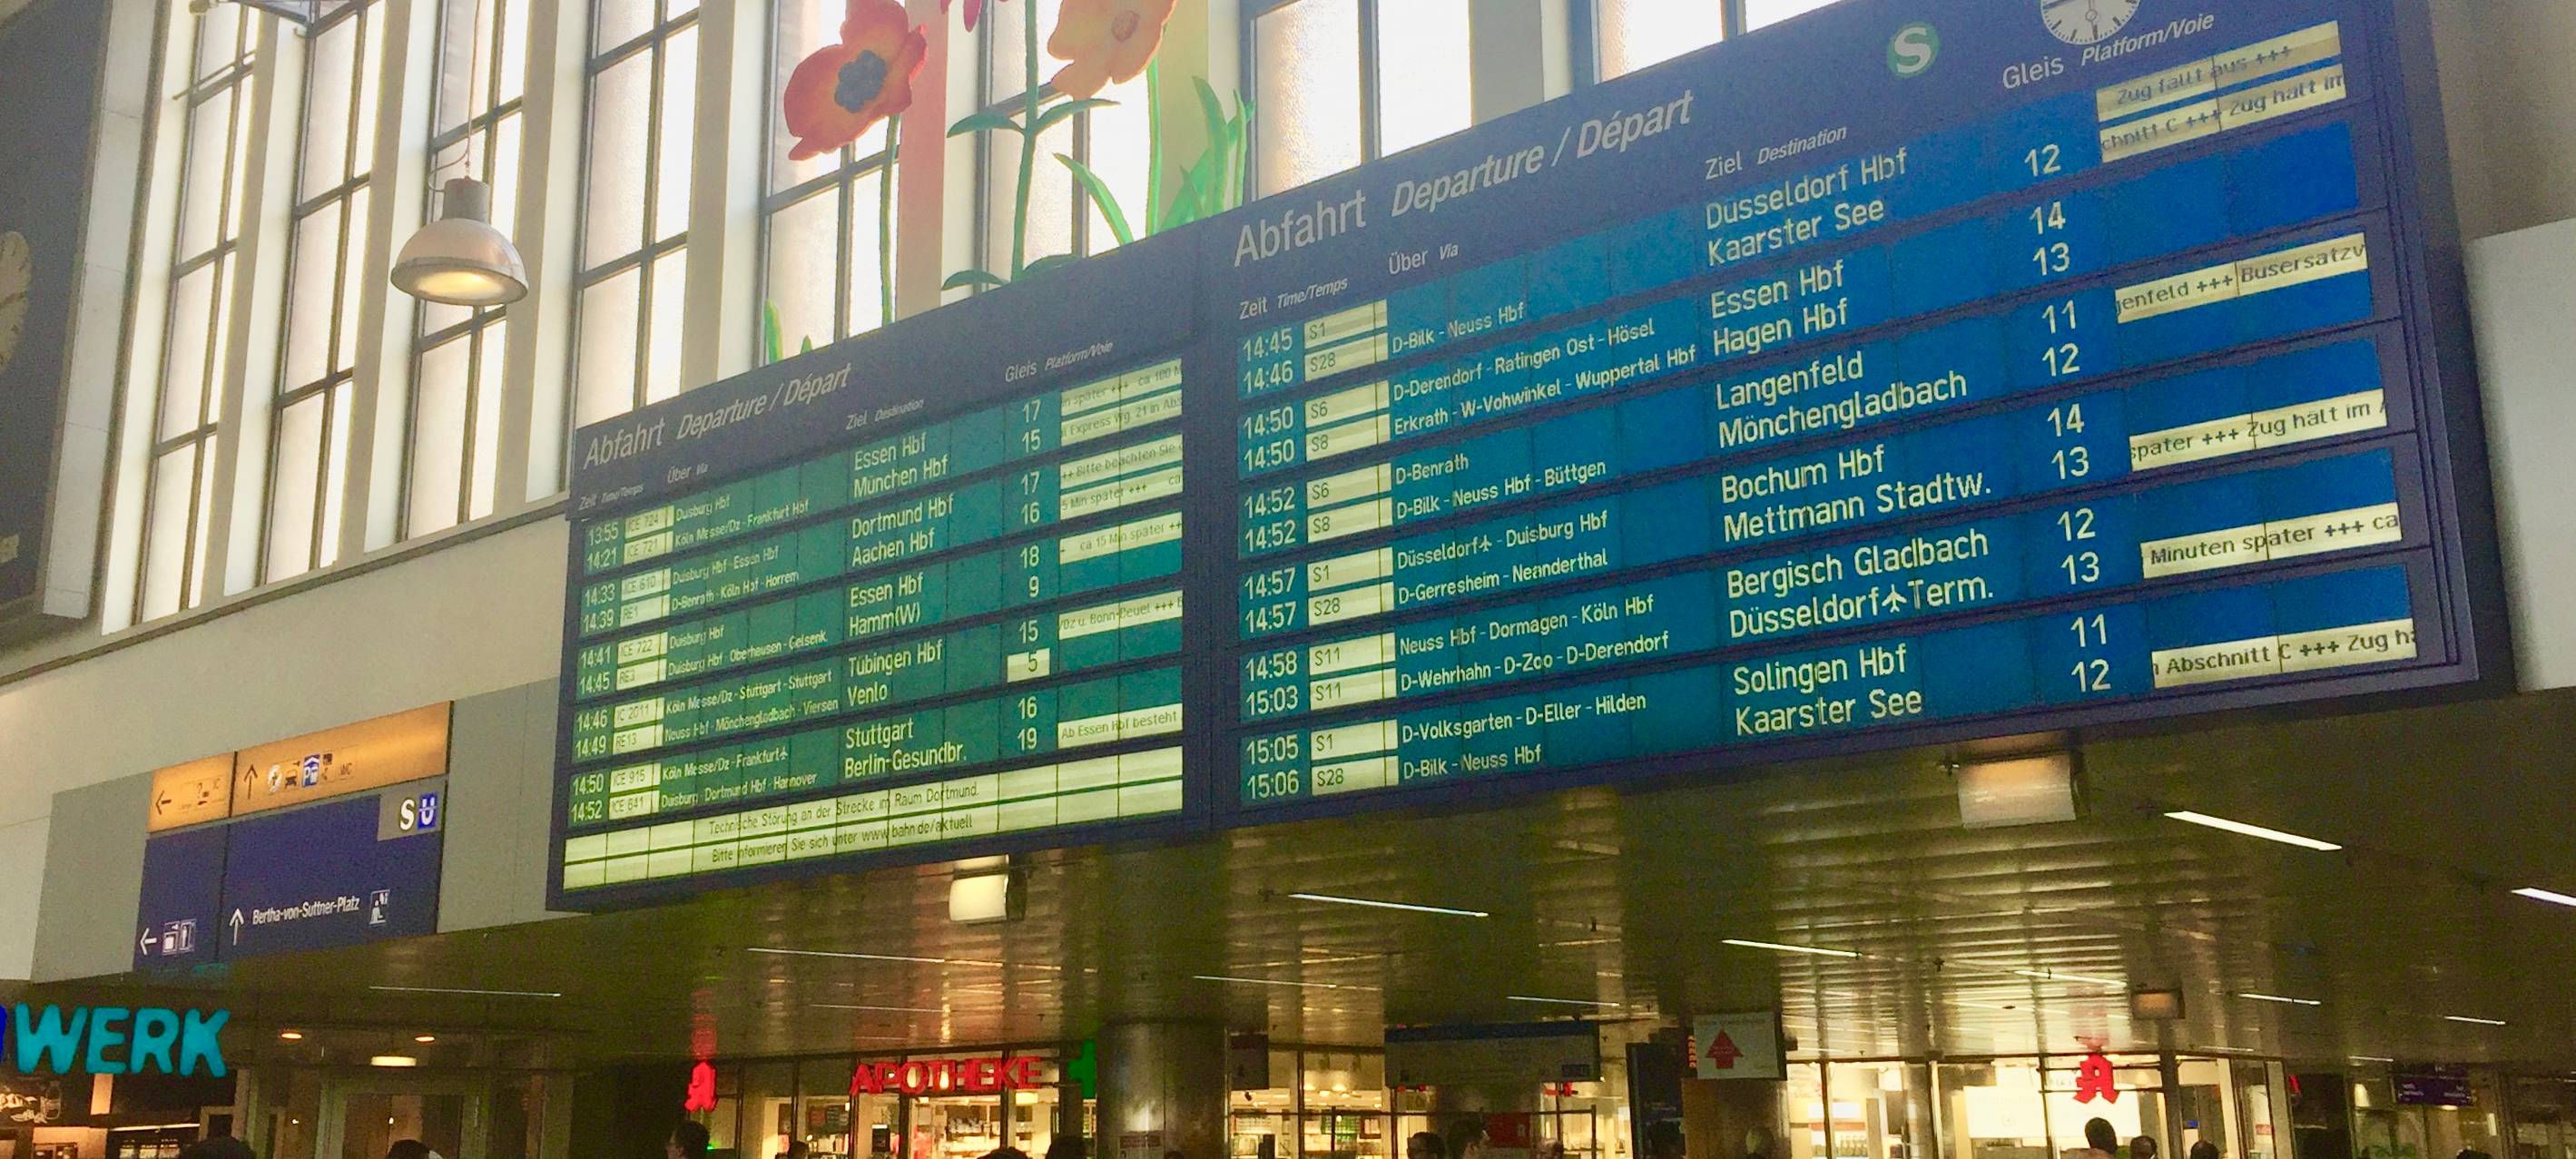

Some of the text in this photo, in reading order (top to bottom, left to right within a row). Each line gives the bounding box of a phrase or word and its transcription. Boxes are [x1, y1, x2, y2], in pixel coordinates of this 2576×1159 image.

[1892, 26, 1934, 74] S
[2002, 11, 2216, 90] Gleis Platform/Voie
[2118, 83, 2151, 106] Zug
[1705, 125, 1847, 181] Ziel Destination
[1861, 148, 1907, 185] Hbf
[2024, 143, 2061, 177] 12
[1234, 89, 1695, 268] Abfahrt Departure Départ
[1708, 197, 1885, 266] Kaarster See
[2030, 201, 2066, 235] 14
[1390, 242, 1460, 275] Über Via
[2032, 241, 2070, 276] 13
[1240, 277, 1348, 320] Zeit Time/Temps
[1711, 260, 1844, 319] Essen Hbf
[1310, 322, 1327, 340] S1
[1392, 302, 1525, 356] D-Bilk Neuss Hbf
[1713, 298, 1848, 356] Hagen Hbf
[2042, 300, 2076, 334] 11
[1005, 340, 1114, 382] Gleis Platform/Voie
[1242, 327, 1294, 363] 14:45
[1393, 319, 1656, 403] D-Derendorf Ratingen Ost Hösel
[2042, 341, 2079, 377] 12
[1242, 360, 1294, 395] 14:46
[1310, 352, 1337, 374] S28
[1716, 350, 1864, 409] Langenfeld
[1394, 346, 1696, 436] Erkrath W-Vohwinkel Wuppertal Hbf
[584, 364, 852, 469] Abfahrt Departure Départ
[846, 410, 868, 430] Ziel
[1023, 400, 1040, 423] 17
[1243, 406, 1295, 441] 14:50
[1311, 401, 1329, 420] S6
[1717, 371, 1967, 448] Mönchengladbach
[2047, 403, 2085, 437] 14
[854, 432, 928, 471] Essen Hbf
[1022, 430, 1040, 453] 15
[1244, 439, 1295, 473] 14:50
[1311, 434, 1329, 453] S8
[667, 465, 691, 485] Über
[923, 456, 949, 477] Hbf
[1395, 456, 1470, 486] D-Benrath
[1721, 444, 1885, 504] Bochum Hbf
[2050, 446, 2089, 480] 13
[1021, 473, 1040, 496] 17
[1397, 462, 1607, 520] D-Bilk Neuss Hbf Büttgen
[852, 493, 954, 538] Dortmund Hbf
[1021, 502, 1040, 525] 16
[1244, 486, 1296, 518] 14:52
[1724, 472, 1991, 542] Mettmann Stadtw.
[1506, 510, 1608, 550] Duisburg Hbf
[852, 528, 936, 567] Aachen Hbf
[1020, 545, 1039, 568] 18
[1727, 527, 1989, 599] Bergisch Gladbach
[2150, 540, 2236, 565] Minuten
[850, 572, 924, 607] Essen Hbf
[1028, 575, 1039, 598] 9
[1244, 569, 1296, 600] 14:57
[1398, 548, 1608, 604] D-Gerresheim Neanderthal
[849, 603, 921, 637] Hamm(W)
[1313, 597, 1342, 618] S28
[1489, 594, 1655, 641] Dormagen Köln Hbf
[1019, 620, 1038, 643] 15
[2070, 614, 2108, 648] 11
[581, 646, 611, 668] 14:41
[730, 641, 782, 663] Oberhausen
[917, 640, 943, 663] Hbf
[1027, 652, 1038, 673] 5
[1314, 646, 1342, 666] S11
[1401, 632, 1670, 691] D-Wehrhahn D-Zoo D-Derendorf
[2167, 634, 2389, 673] Abschnitt C Zug
[580, 671, 611, 692] 14:45
[740, 670, 832, 702] Stuttgart Stuttgart
[1733, 643, 1907, 695] Solingen Hbf
[2070, 659, 2111, 692] 12
[848, 683, 888, 707] Venlo
[1018, 696, 1037, 720] 16
[1245, 685, 1299, 716] 15:03
[577, 709, 607, 732] 14:46
[1061, 711, 1177, 739] Ab Essen besteht
[1401, 693, 1647, 743] D-Volksgarten D-Eller Hilden
[1735, 689, 1922, 736] Kaarster See
[575, 736, 606, 758] 14:49
[846, 719, 914, 751] Stuttgart
[1018, 727, 1037, 751] 19
[1246, 734, 1300, 765] 15:05
[844, 741, 967, 780] Berlin-Gesundbr.
[1316, 768, 1344, 786] S28
[573, 774, 605, 796] 14:50
[773, 773, 817, 791] Hannover
[1246, 769, 1300, 800] 15:06
[400, 796, 436, 830] S U
[571, 800, 602, 822] 14:52
[709, 817, 758, 834] Technische
[801, 810, 812, 820] an
[817, 806, 831, 819] der
[836, 799, 875, 816] Strecke
[895, 791, 922, 807] Raum
[712, 848, 732, 862] Bitte
[791, 837, 805, 850] Sie
[809, 835, 829, 848] sich
[832, 832, 857, 847] unter
[252, 895, 361, 925] Bertha-von-Suttner-Platz
[0, 1002, 231, 1077] WERK
[850, 1057, 1042, 1095] APOTHEKE
